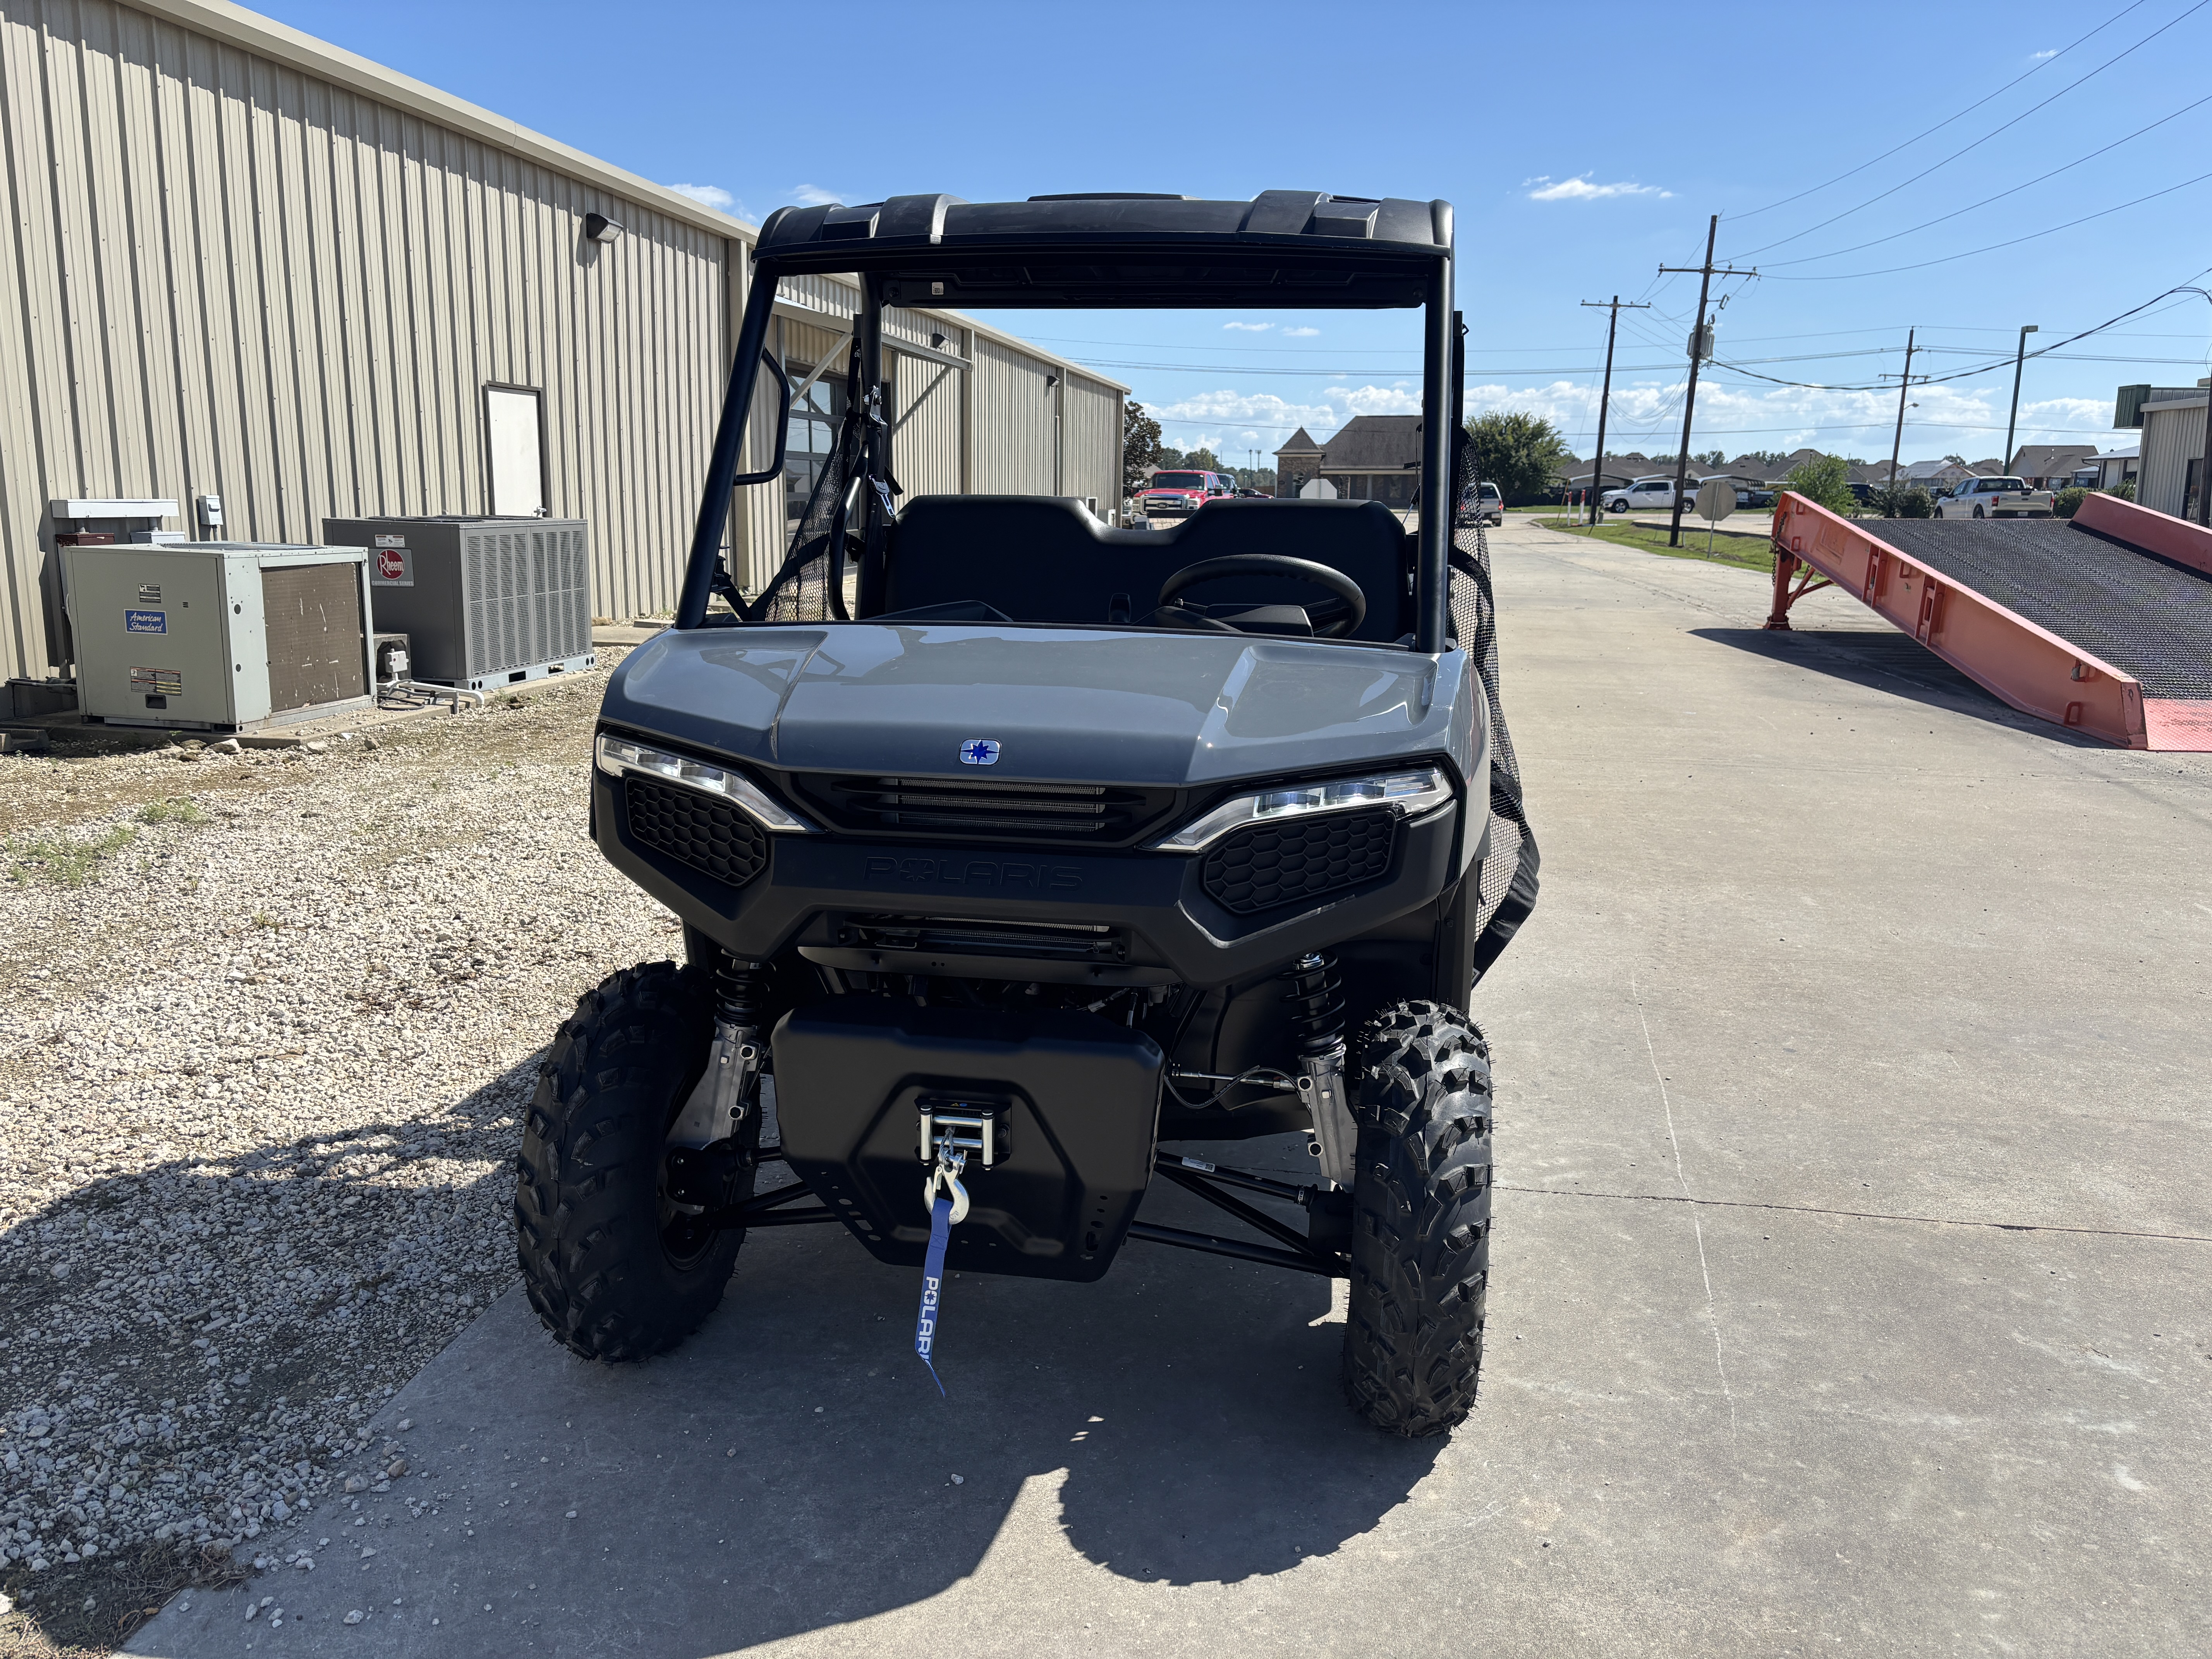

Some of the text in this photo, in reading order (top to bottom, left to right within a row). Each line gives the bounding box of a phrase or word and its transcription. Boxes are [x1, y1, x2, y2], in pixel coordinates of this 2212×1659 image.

[379, 550, 403, 575] Rheem
[130, 612, 162, 622] American
[129, 622, 163, 632] Standard
[863, 857, 1083, 890] POLARIS
